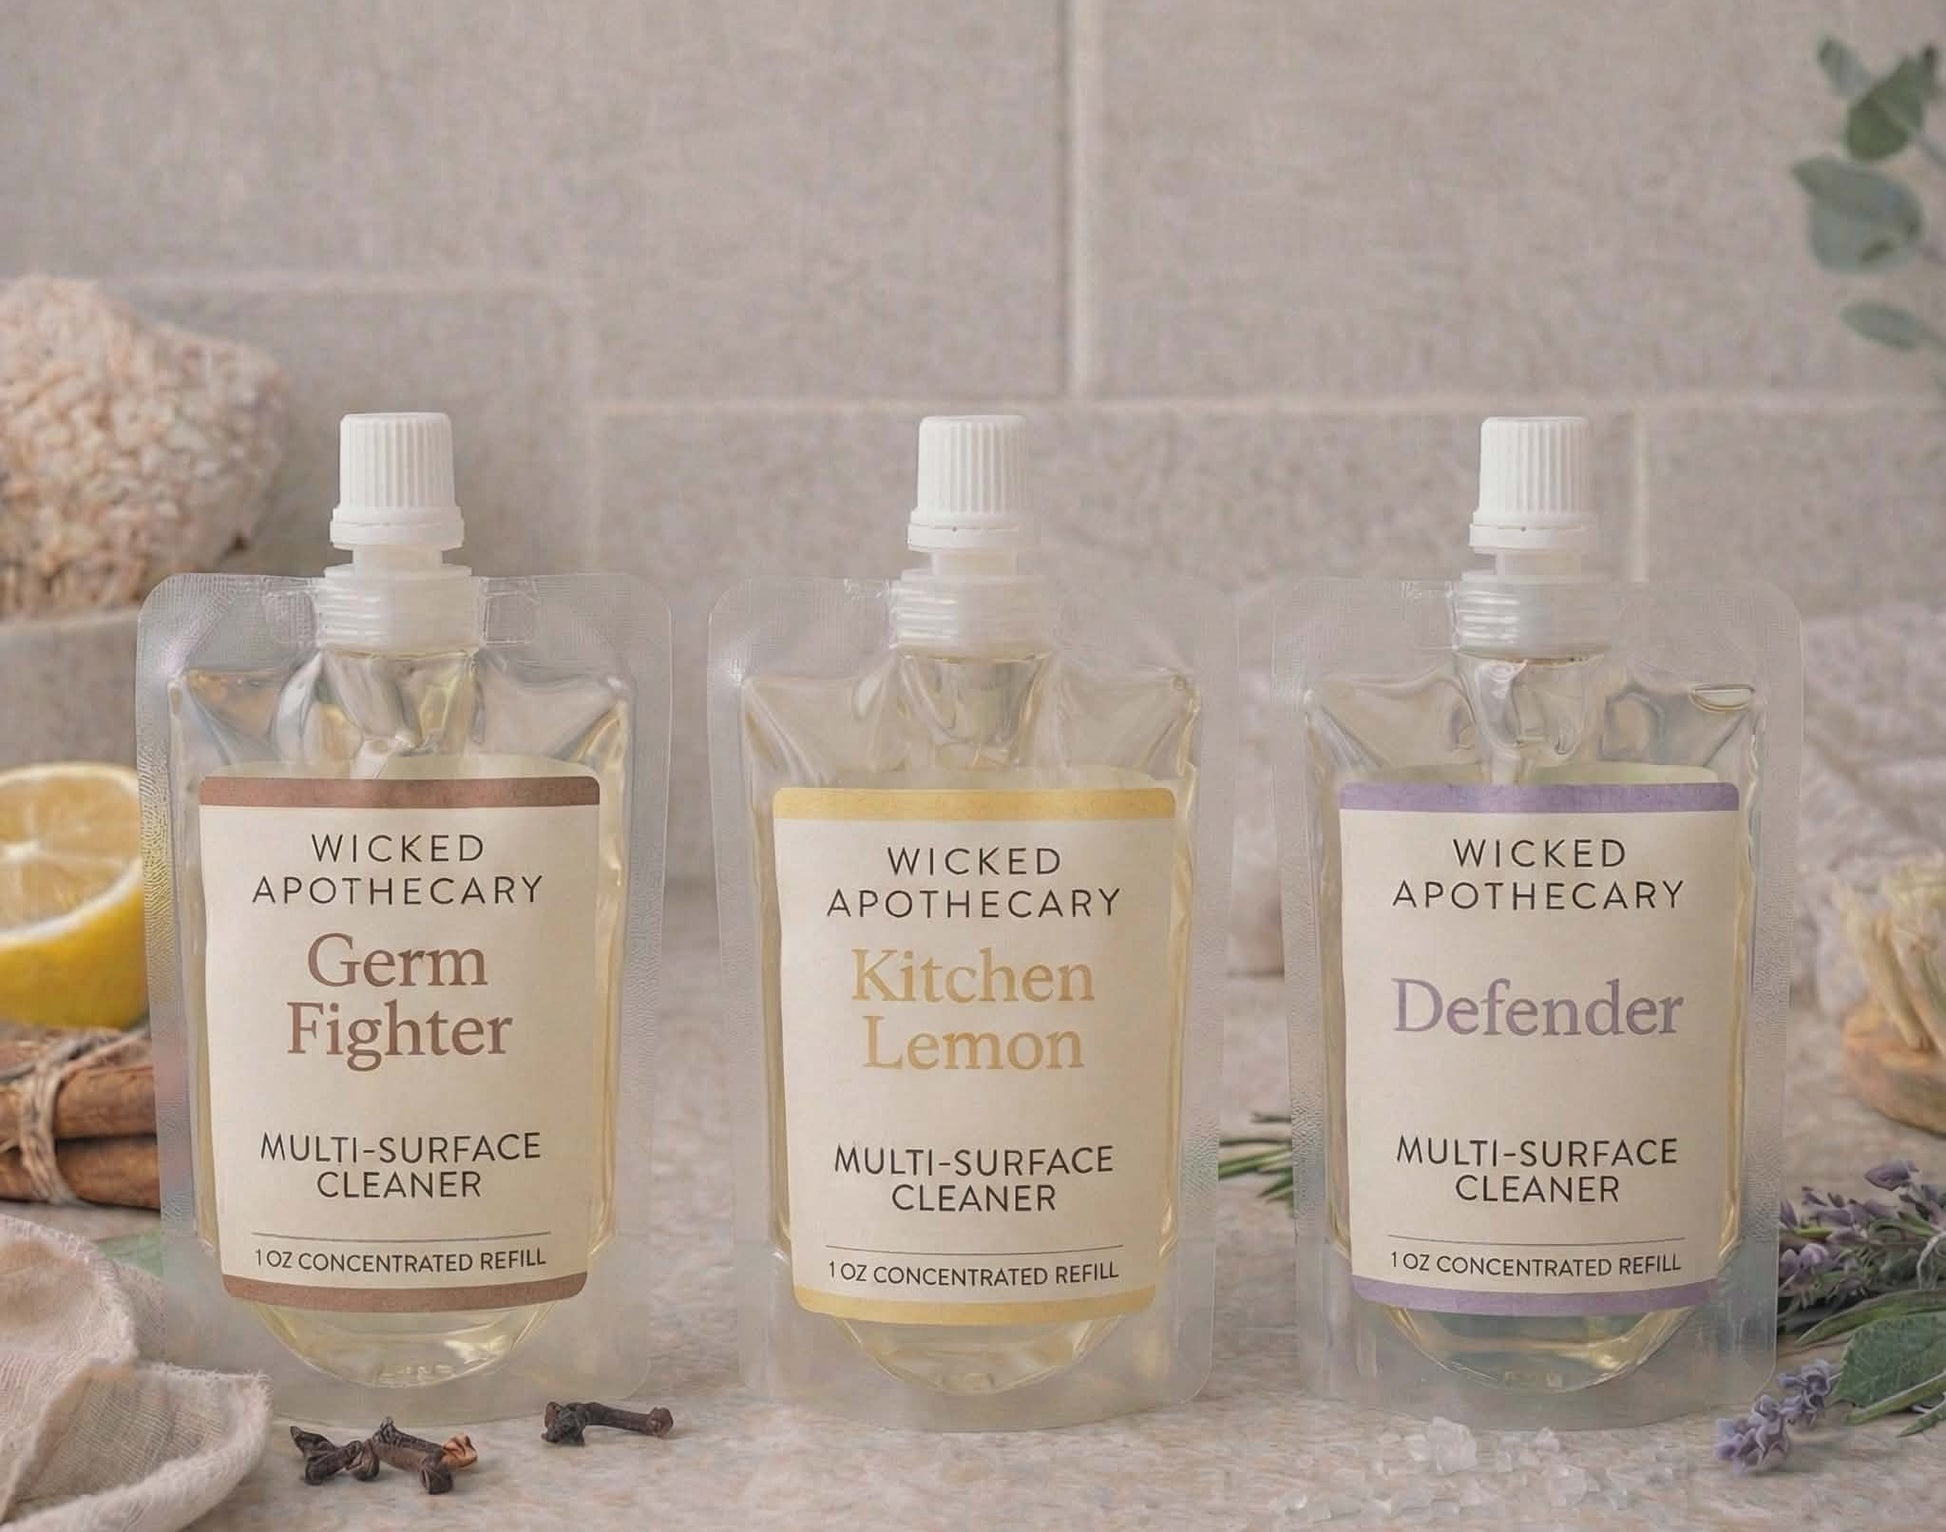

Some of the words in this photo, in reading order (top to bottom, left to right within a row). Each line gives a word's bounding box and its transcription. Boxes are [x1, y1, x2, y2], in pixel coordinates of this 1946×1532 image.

[312, 834, 483, 863] WICKED
[887, 847, 1060, 877] WICKED
[1453, 838, 1625, 869] WICKED
[252, 875, 542, 905] APOTHECARY
[827, 887, 1120, 918] APOTHECARY
[1392, 880, 1683, 910] APOTHECARY
[308, 933, 489, 987] Germ
[852, 947, 1094, 1004] Kitchen
[1392, 978, 1684, 1037] Defender
[287, 998, 513, 1072] Fighter
[862, 1014, 1084, 1071] Lemon
[261, 1132, 540, 1164] MULTI-SURFACE
[835, 1144, 1113, 1177] MULTI-SURFACE
[1397, 1135, 1677, 1169] MULTI-SURFACE
[317, 1171, 481, 1199] CLEANER
[892, 1184, 1055, 1212] CLEANER
[1455, 1175, 1619, 1203] CLEANER
[255, 1248, 262, 1267] 1
[266, 1250, 293, 1269] OZ
[298, 1253, 473, 1273] CONCENTRATED
[480, 1248, 546, 1270] REFILL
[828, 1259, 835, 1279] 1
[841, 1263, 867, 1281] OZ
[874, 1266, 1048, 1287] CONCENTRATED
[1056, 1261, 1119, 1284] REFILL
[1391, 1250, 1398, 1268] 1
[1403, 1253, 1432, 1271] OZ
[1436, 1256, 1612, 1277] CONCENTRATED
[1619, 1254, 1681, 1275] REFILL
